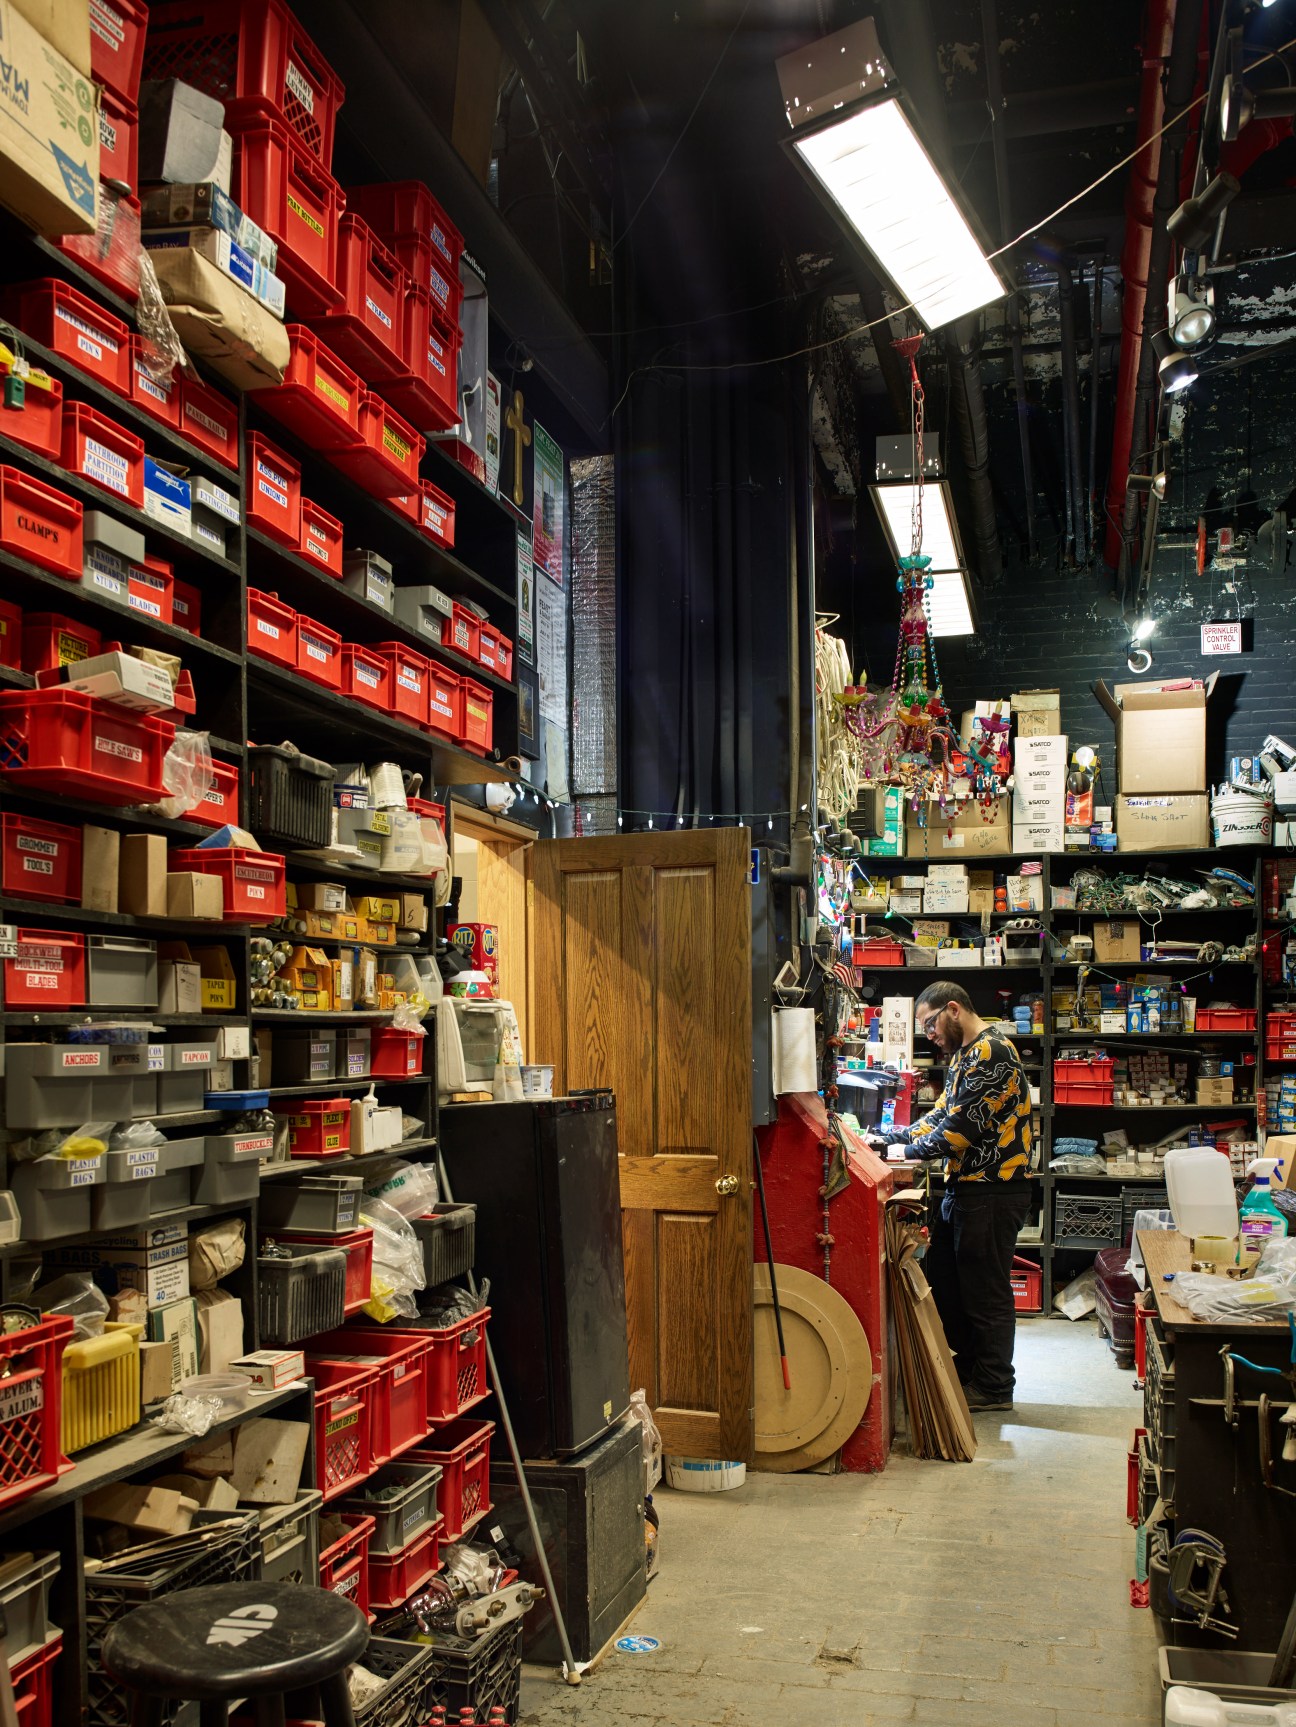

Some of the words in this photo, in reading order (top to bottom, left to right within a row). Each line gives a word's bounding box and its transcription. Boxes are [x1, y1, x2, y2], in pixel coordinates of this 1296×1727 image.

[302, 209, 323, 236] BOTTLES
[80, 338, 100, 357] PIN'S
[141, 379, 165, 400] TOOL'S
[88, 440, 127, 469] BATHROOM
[85, 465, 106, 483] DOOR
[87, 455, 125, 482] PARTITION
[215, 488, 228, 502] FIRE
[18, 515, 59, 544] CLAMP'S
[90, 559, 125, 583] THREADED
[149, 576, 164, 589] SAW
[1204, 626, 1238, 634] SPRINKLER
[61, 633, 87, 651] PICTURE
[117, 742, 140, 760] SAW'S
[1222, 822, 1263, 833] ZINSSER
[19, 837, 56, 854] GROMMET
[26, 858, 51, 873] TOOL'S
[249, 887, 263, 897] PIN'S
[453, 933, 474, 945] RITZ
[484, 933, 495, 950] RITZ
[15, 958, 63, 971] MULTI-TOOL
[28, 975, 57, 987] BLADES
[207, 981, 225, 989] TAPER
[209, 994, 224, 1003] PIN'S
[65, 1054, 99, 1066] ANCHORS
[112, 1054, 140, 1065] ANCHORS
[184, 1052, 209, 1062] TAPCON
[350, 1065, 362, 1073] FLUX
[235, 1138, 273, 1152] TURNBUCKLES
[327, 1137, 339, 1146] GLUE
[69, 1158, 100, 1170] PLASTIC
[129, 1152, 157, 1164] PLASTIC
[73, 1172, 94, 1185] BAG'S
[135, 1166, 155, 1178] BAG'S
[149, 1248, 170, 1262] TRASH
[171, 1245, 187, 1257] BAGS
[156, 1290, 166, 1302] 40
